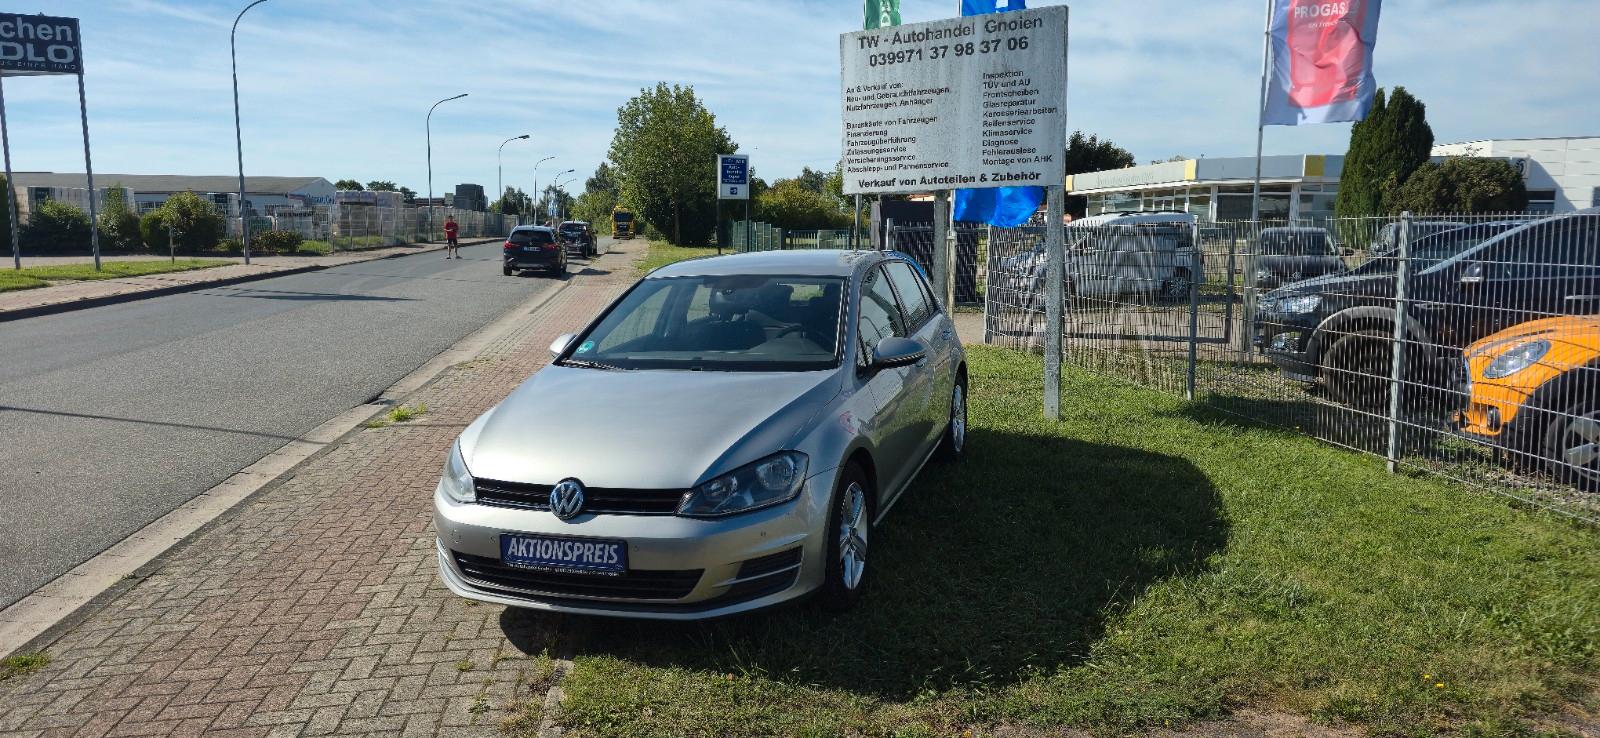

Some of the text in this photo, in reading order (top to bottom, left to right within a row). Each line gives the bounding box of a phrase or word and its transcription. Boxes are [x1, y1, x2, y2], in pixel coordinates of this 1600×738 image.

[1294, 3, 1346, 18] PROGAS
[858, 35, 880, 49] TW
[892, 22, 976, 45] Autohandel
[984, 16, 1042, 34] Gnoien
[869, 36, 1029, 67] 039971 37 98 37 06
[982, 70, 1024, 80] Inspektion
[863, 83, 888, 92] Verkauf
[983, 78, 1031, 89] TÜV und AU
[982, 88, 1040, 99] Frontscheiben
[899, 98, 934, 107] Anhänger
[982, 98, 1036, 108] Glasreparatur
[982, 106, 1058, 118] Karosseriearbeiten
[898, 115, 938, 125] Fahrzeugen
[982, 118, 1036, 128] Reifenservice
[846, 129, 888, 139] Finanzierung
[982, 128, 1033, 137] Klimaservice
[847, 136, 917, 147] Fahrzeugüberführung
[982, 139, 1019, 148] Diagnose
[846, 145, 907, 156] Zulassungsservice
[982, 147, 1037, 156] Fehlerauslese
[847, 154, 916, 164] Versicherungsservice
[982, 157, 1015, 166] Montage
[1034, 154, 1053, 163] AHK
[847, 160, 949, 174] Abschlepp- und Pannenservice
[858, 171, 1042, 188] Verkauf von Autoteilen & Zubehör
[507, 537, 619, 564] AKTIONSPREIS
